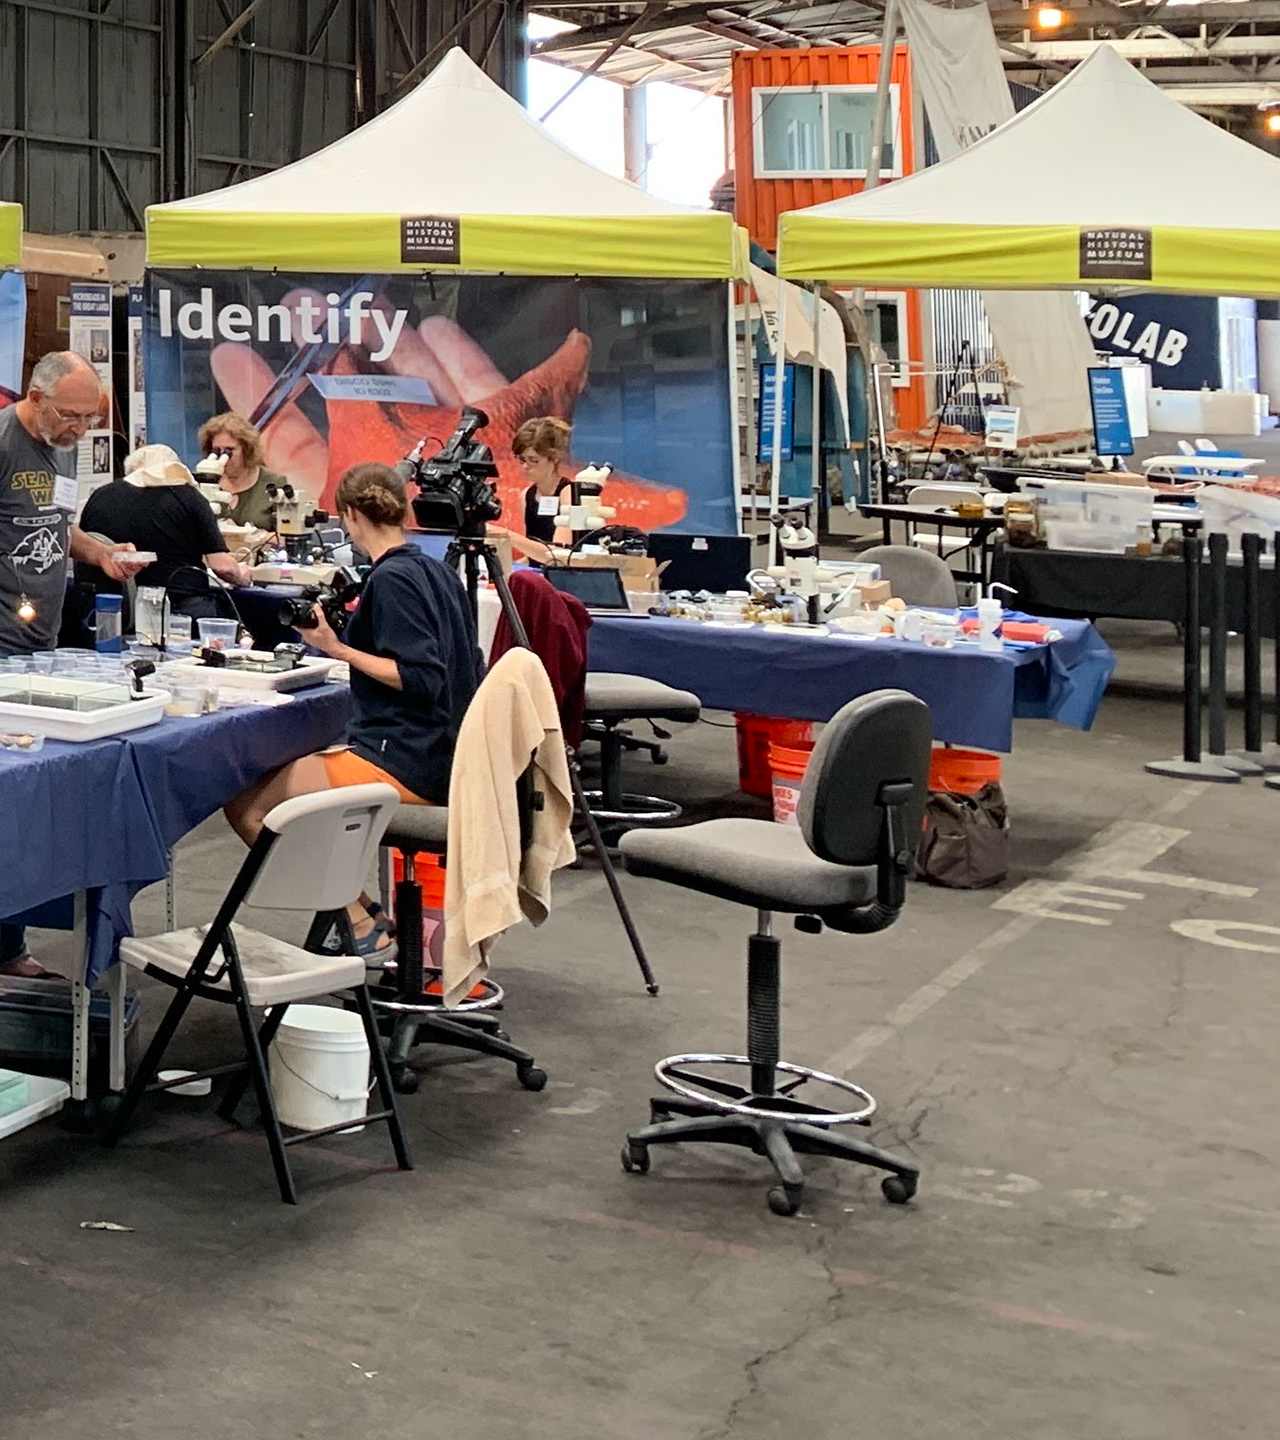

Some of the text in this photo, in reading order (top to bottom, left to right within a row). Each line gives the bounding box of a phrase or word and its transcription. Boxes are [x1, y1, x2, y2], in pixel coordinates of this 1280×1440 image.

[406, 220, 453, 229] NATURAL
[406, 229, 454, 237] HISTORY
[1087, 231, 1144, 240] NATURAL
[406, 237, 454, 245] MUSEUM
[1087, 241, 1144, 250] HISTORY
[1086, 250, 1144, 259] MUSEUM
[158, 287, 409, 362] Identify
[11, 471, 54, 490] SEA
